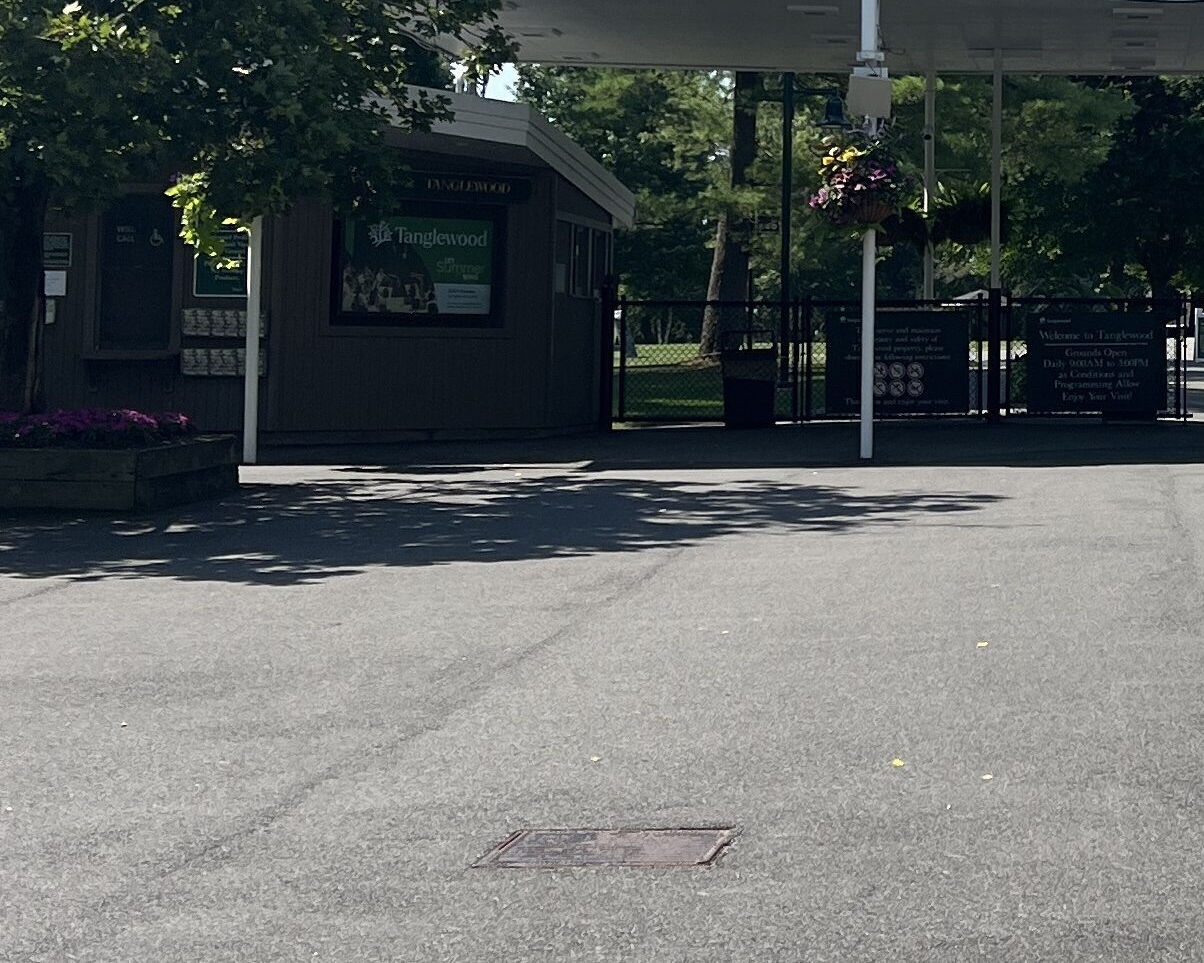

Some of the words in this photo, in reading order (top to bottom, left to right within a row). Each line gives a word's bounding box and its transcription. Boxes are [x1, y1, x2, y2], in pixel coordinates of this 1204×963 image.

[426, 177, 512, 194] TANGLEWOOD
[395, 226, 488, 249] Tanglewood
[1038, 329, 1081, 340] Welcome
[1083, 332, 1094, 340] to
[1096, 329, 1154, 341] Tanglewood
[1064, 347, 1102, 357] Grounds
[1103, 347, 1127, 358] Open
[1043, 358, 1065, 369] Daily
[1069, 369, 1116, 379] Conditions
[1117, 368, 1135, 378] and
[1053, 379, 1113, 391] Programming
[1115, 378, 1140, 388] Allow
[1062, 391, 1085, 403] Enjoy
[1088, 391, 1107, 401] Your
